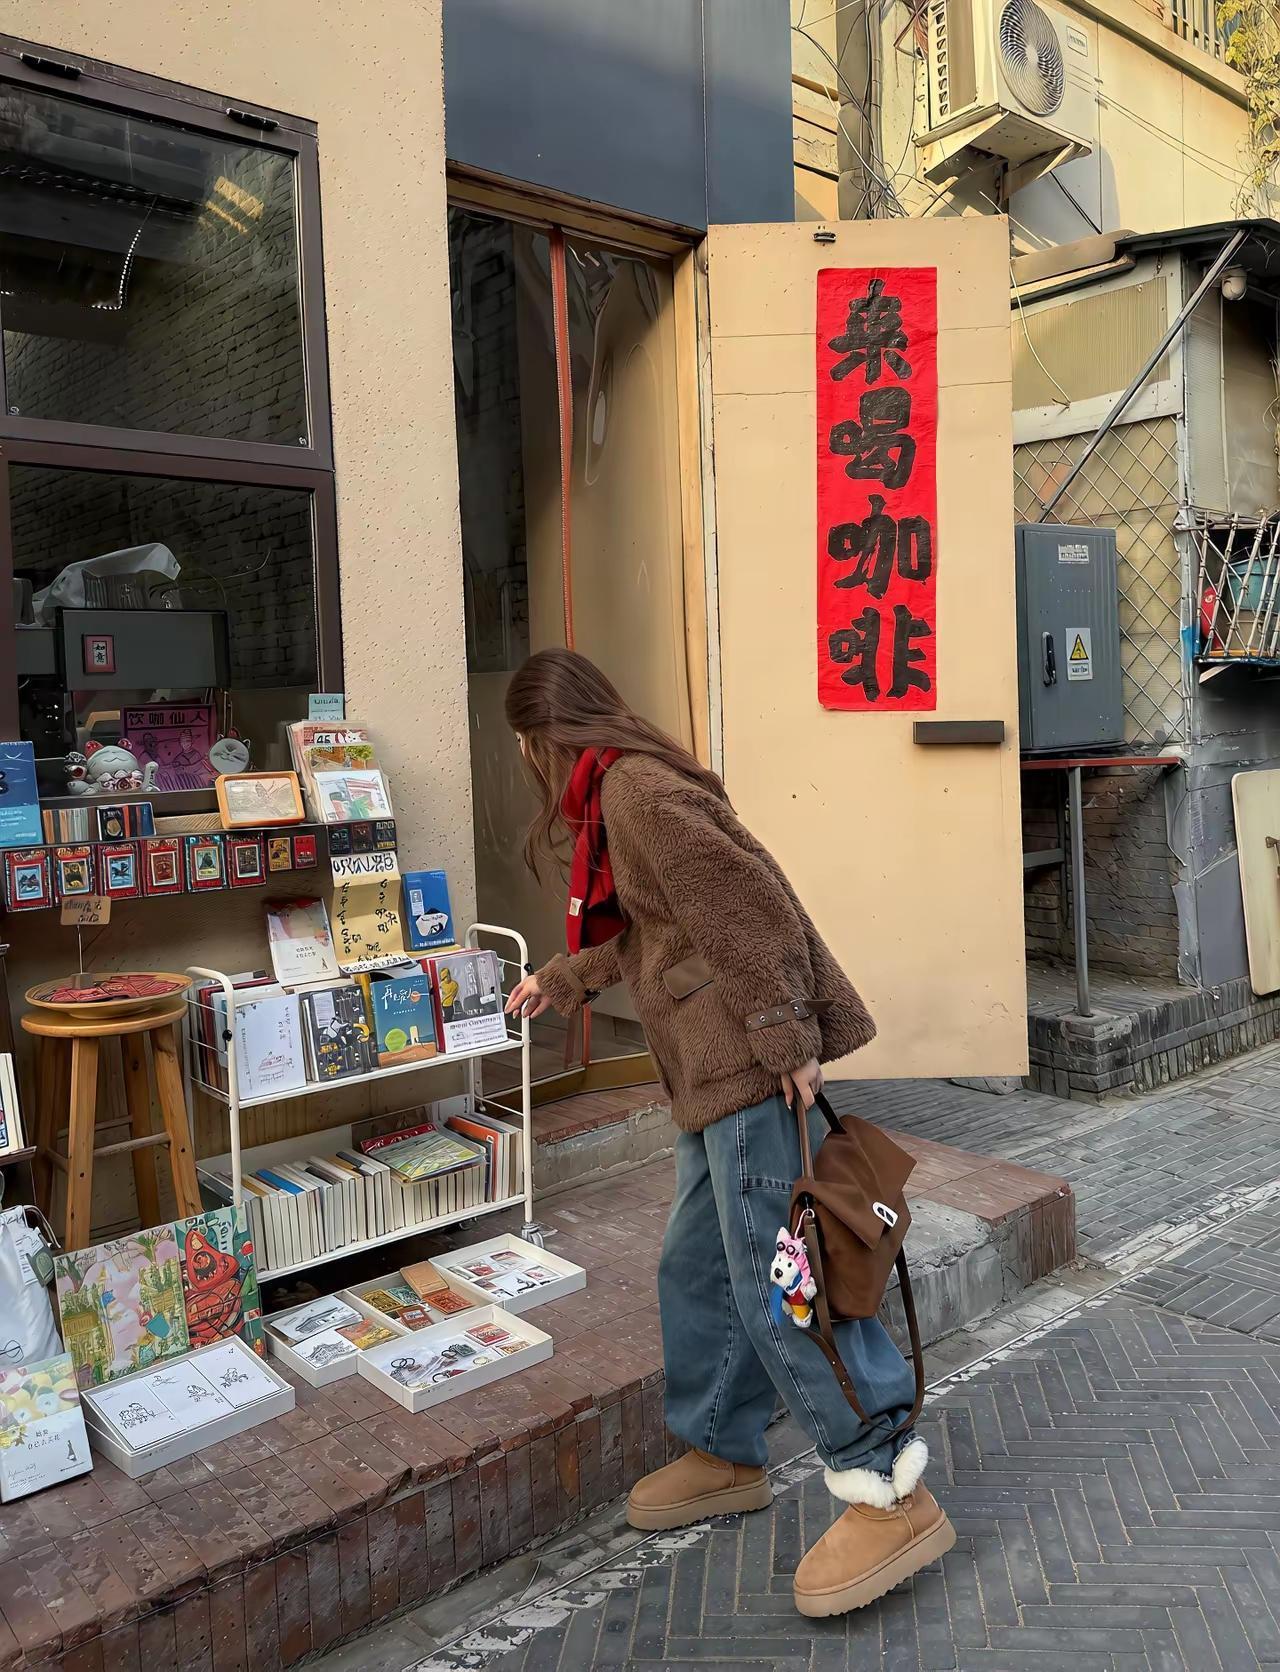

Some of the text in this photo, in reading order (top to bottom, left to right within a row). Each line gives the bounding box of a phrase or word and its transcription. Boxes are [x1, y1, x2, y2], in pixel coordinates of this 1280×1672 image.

[828, 278, 931, 703] 来喝咖啡
[93, 644, 106, 663] 如意
[129, 712, 207, 725] 饮咖仙人
